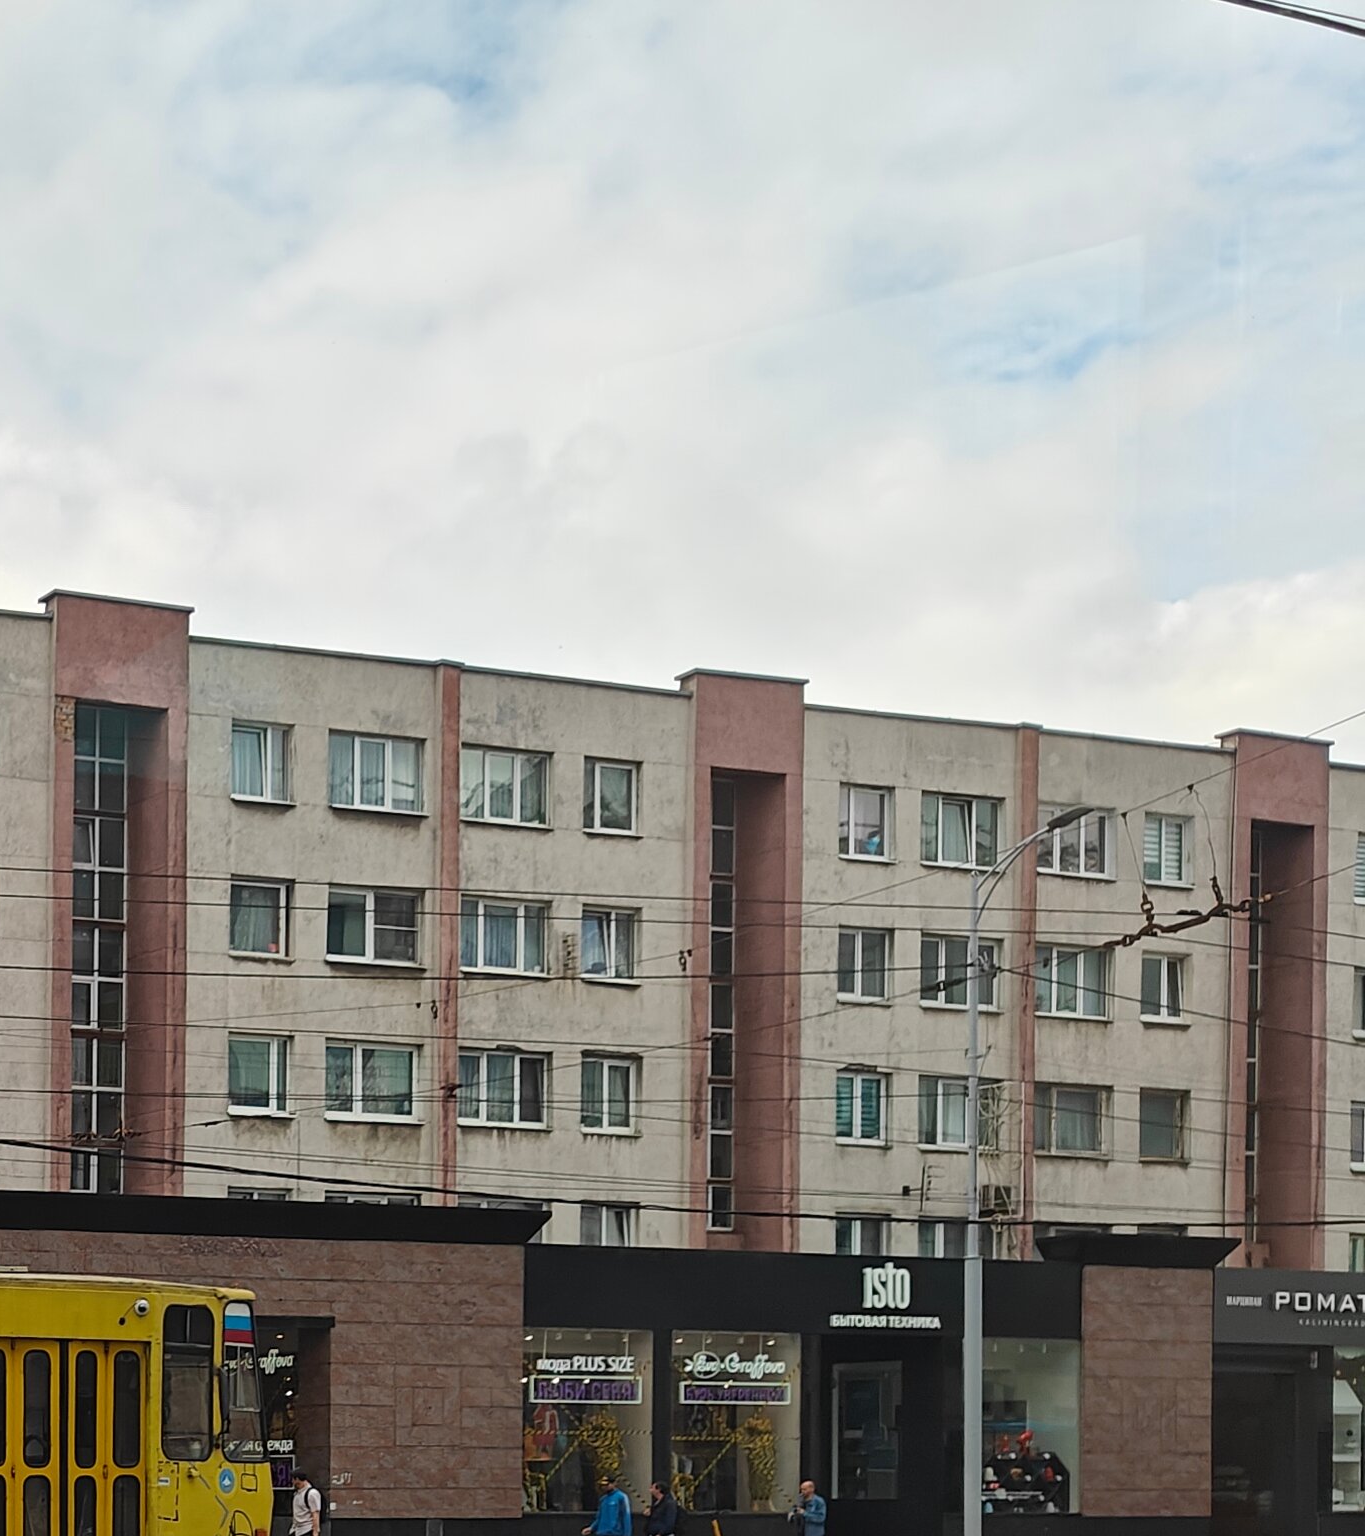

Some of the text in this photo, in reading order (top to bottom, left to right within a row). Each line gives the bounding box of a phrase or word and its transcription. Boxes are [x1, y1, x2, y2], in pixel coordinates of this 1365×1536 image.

[829, 1314, 941, 1329] БЫТОВАЯ ТЕХНИКА
[571, 1355, 606, 1372] PLUS
[607, 1355, 635, 1372] SIZE
